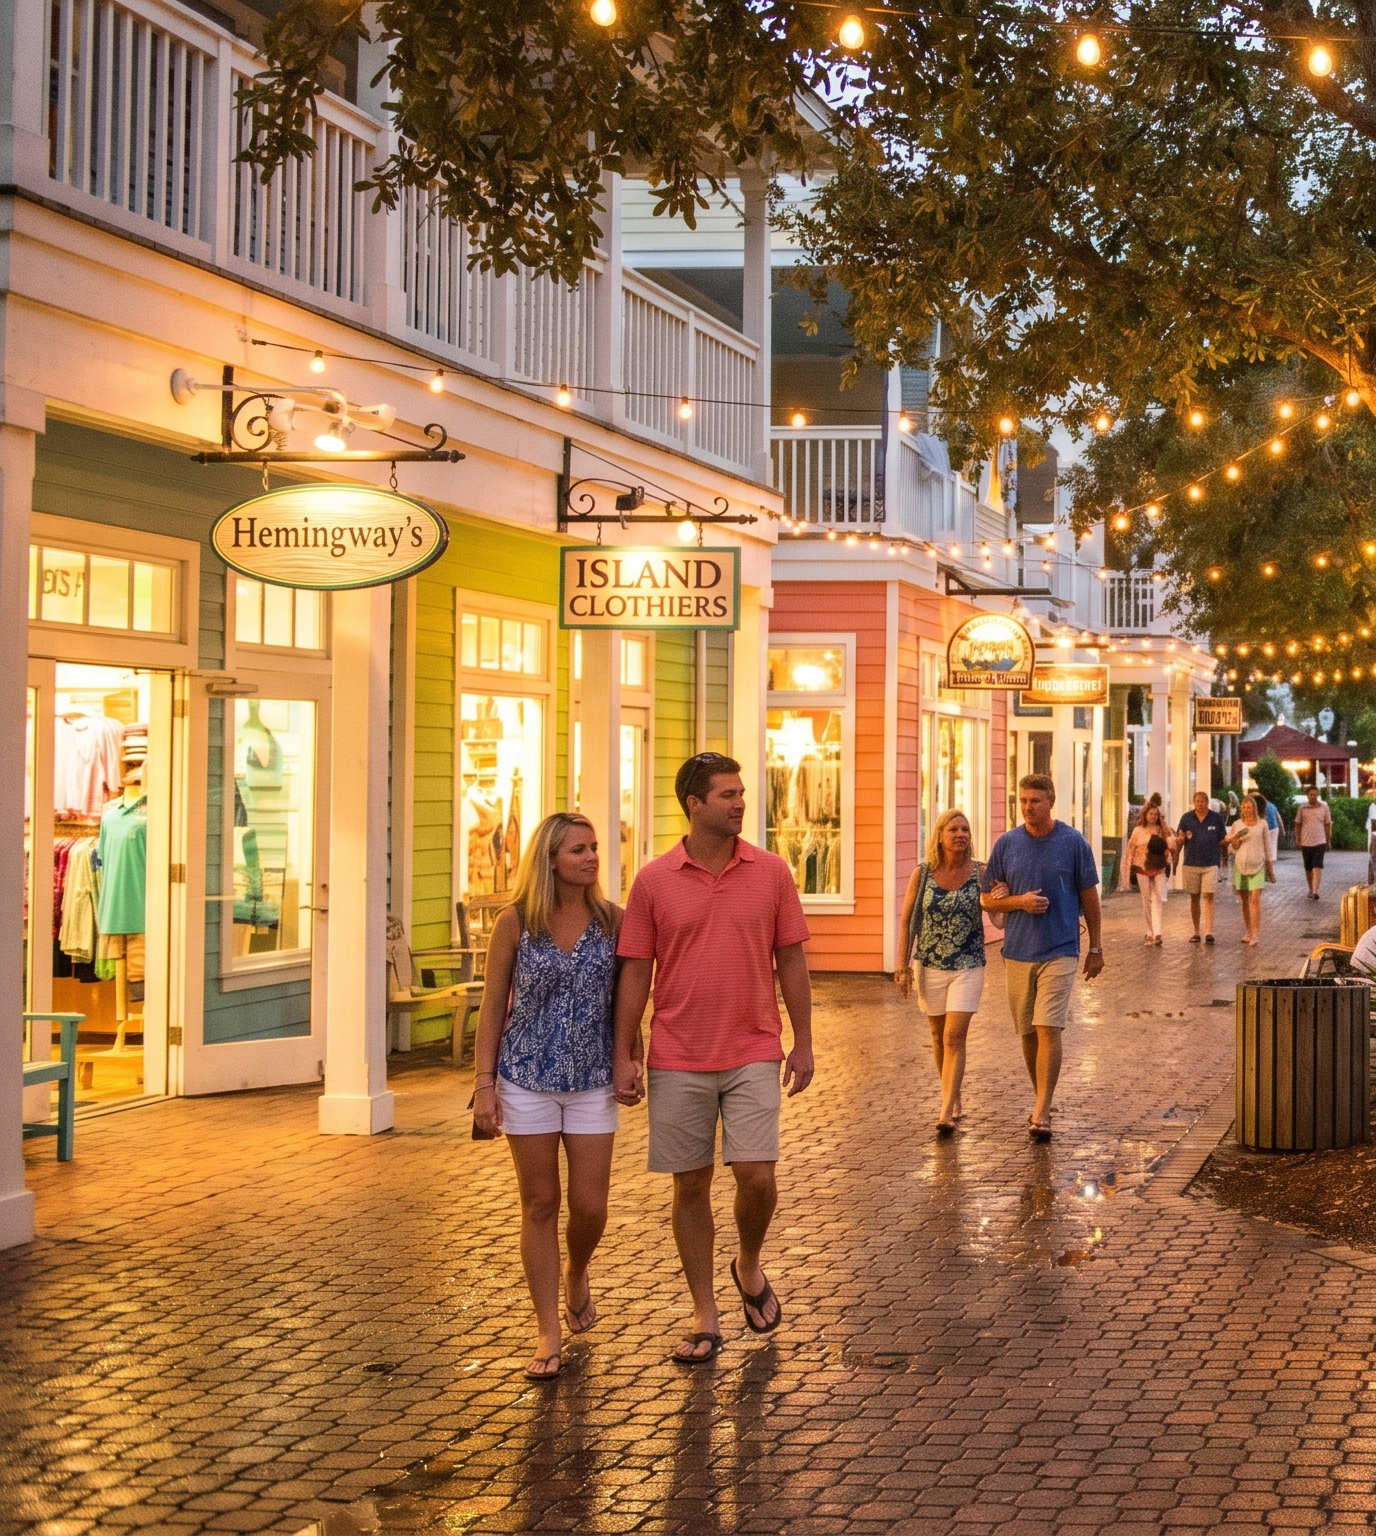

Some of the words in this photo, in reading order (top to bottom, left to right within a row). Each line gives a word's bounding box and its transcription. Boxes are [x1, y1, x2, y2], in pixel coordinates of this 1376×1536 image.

[231, 516, 423, 558] Hemingway's
[575, 559, 722, 589] ISLAND
[569, 595, 728, 618] CLOTHIERS
